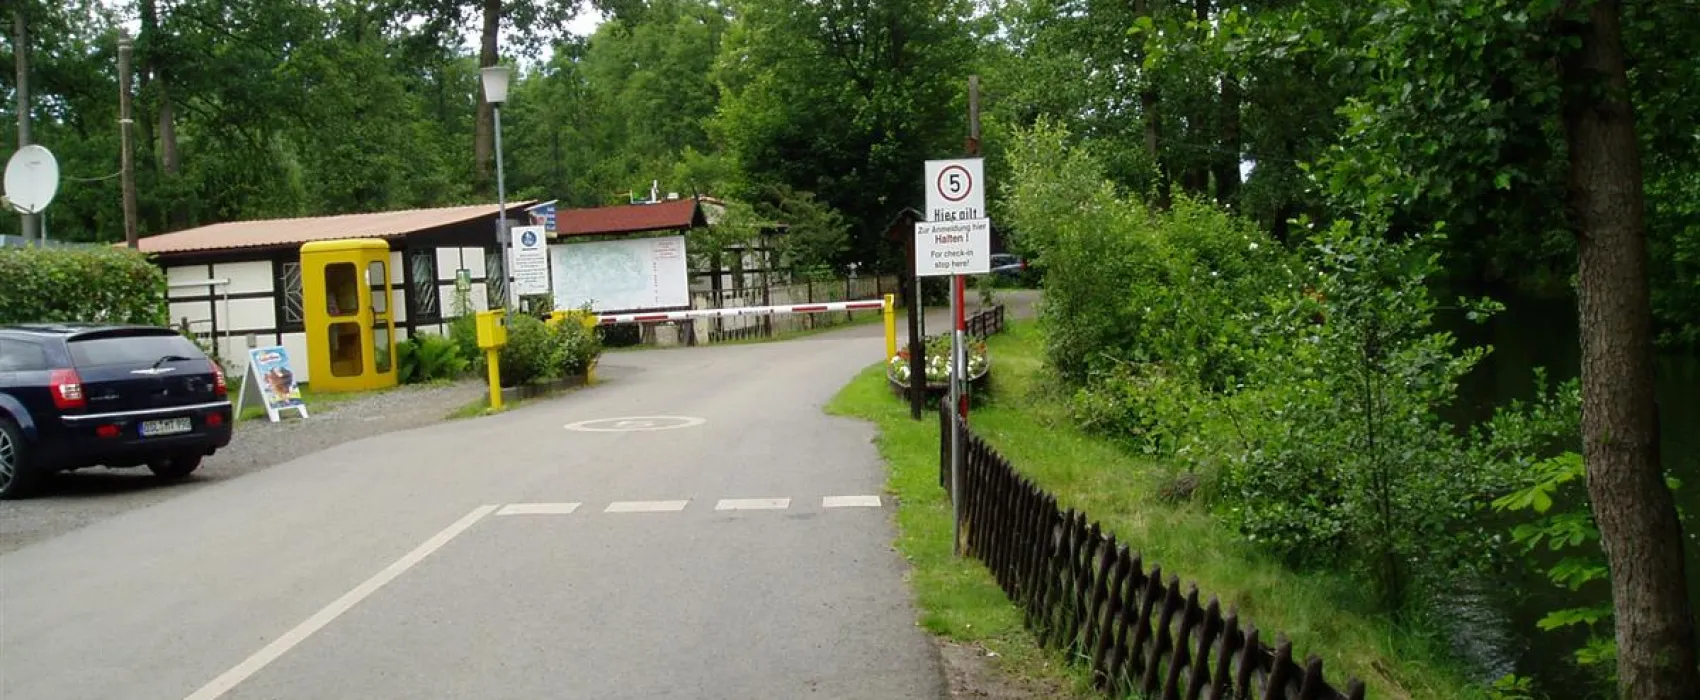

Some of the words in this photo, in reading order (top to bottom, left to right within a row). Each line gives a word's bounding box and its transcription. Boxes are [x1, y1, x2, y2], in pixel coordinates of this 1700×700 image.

[949, 173, 960, 193] 5
[918, 226, 930, 235] Zur
[931, 224, 971, 233] Anmeldung
[972, 221, 987, 231] hier
[934, 233, 964, 245] Halten
[930, 250, 943, 259] For
[943, 248, 974, 258] check-in
[934, 261, 950, 269] stop
